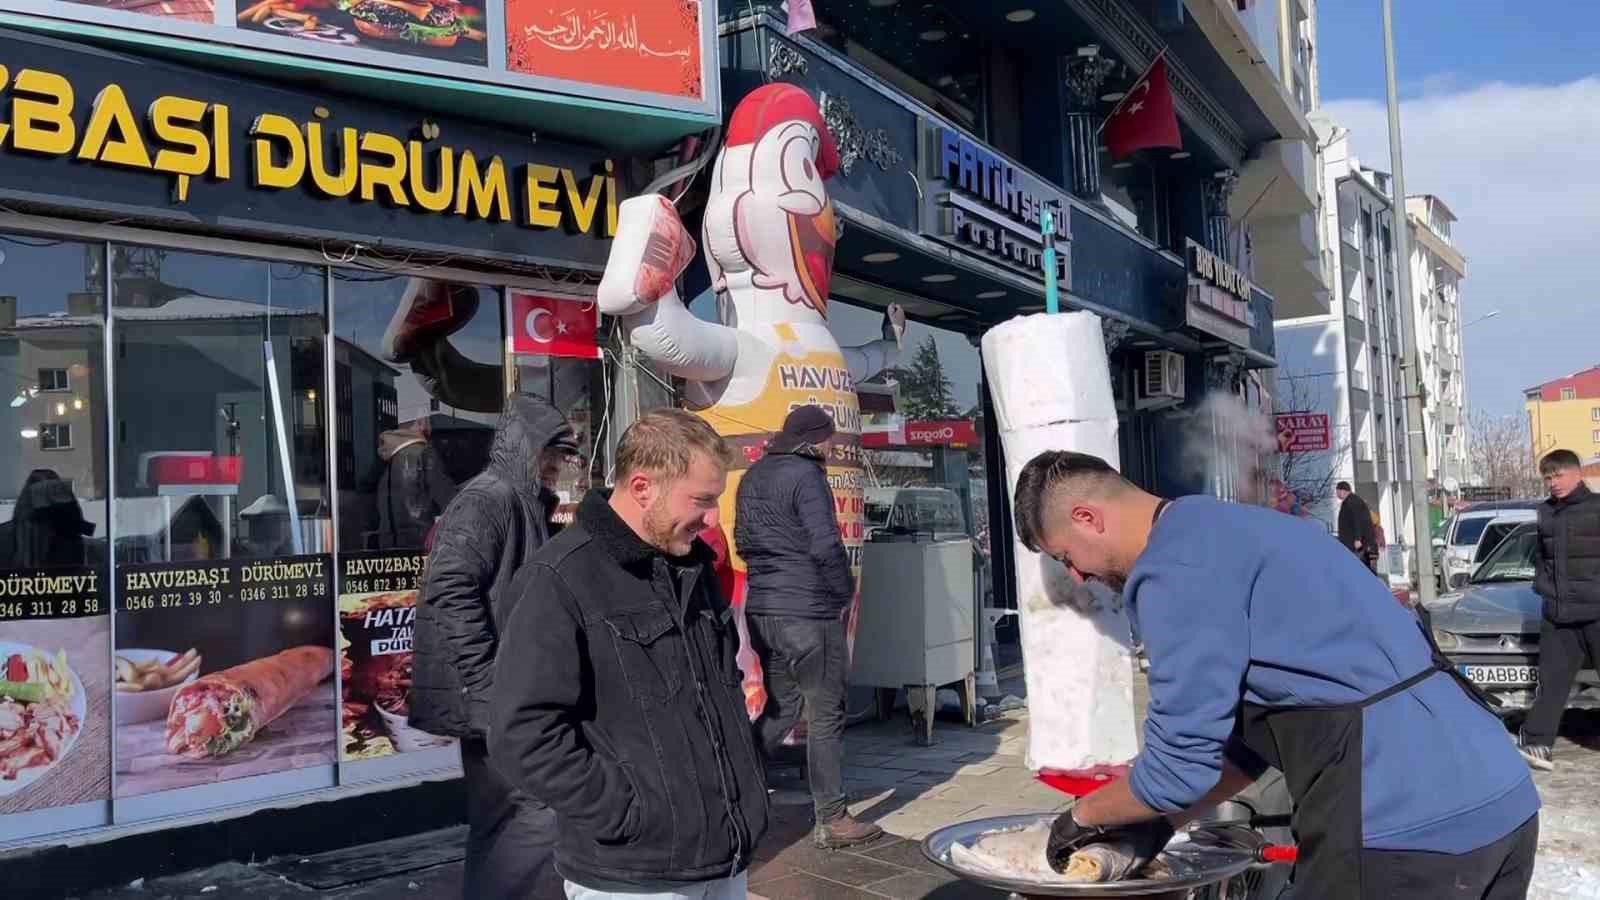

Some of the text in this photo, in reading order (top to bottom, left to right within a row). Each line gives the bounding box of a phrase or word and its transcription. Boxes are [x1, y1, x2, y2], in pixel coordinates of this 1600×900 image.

[0, 64, 230, 201] BAŞI
[527, 159, 617, 237] EVİ
[1022, 192, 1072, 240] ŞEÜL
[1278, 416, 1325, 430] SARAY
[126, 558, 324, 590] HAVUZBAŞI DÜRÜMEVİ
[346, 580, 369, 593] 0546
[374, 578, 391, 591] 872
[396, 577, 407, 589] 39
[31, 601, 53, 616] 311
[61, 600, 76, 614] 28
[84, 598, 99, 613] 58
[126, 596, 154, 610] 0546
[161, 594, 182, 608] 872
[189, 592, 202, 606] 39
[208, 591, 221, 605] 30
[240, 587, 265, 601] 0346
[272, 586, 289, 599] 311
[296, 584, 308, 597] 28
[313, 583, 325, 596] 58
